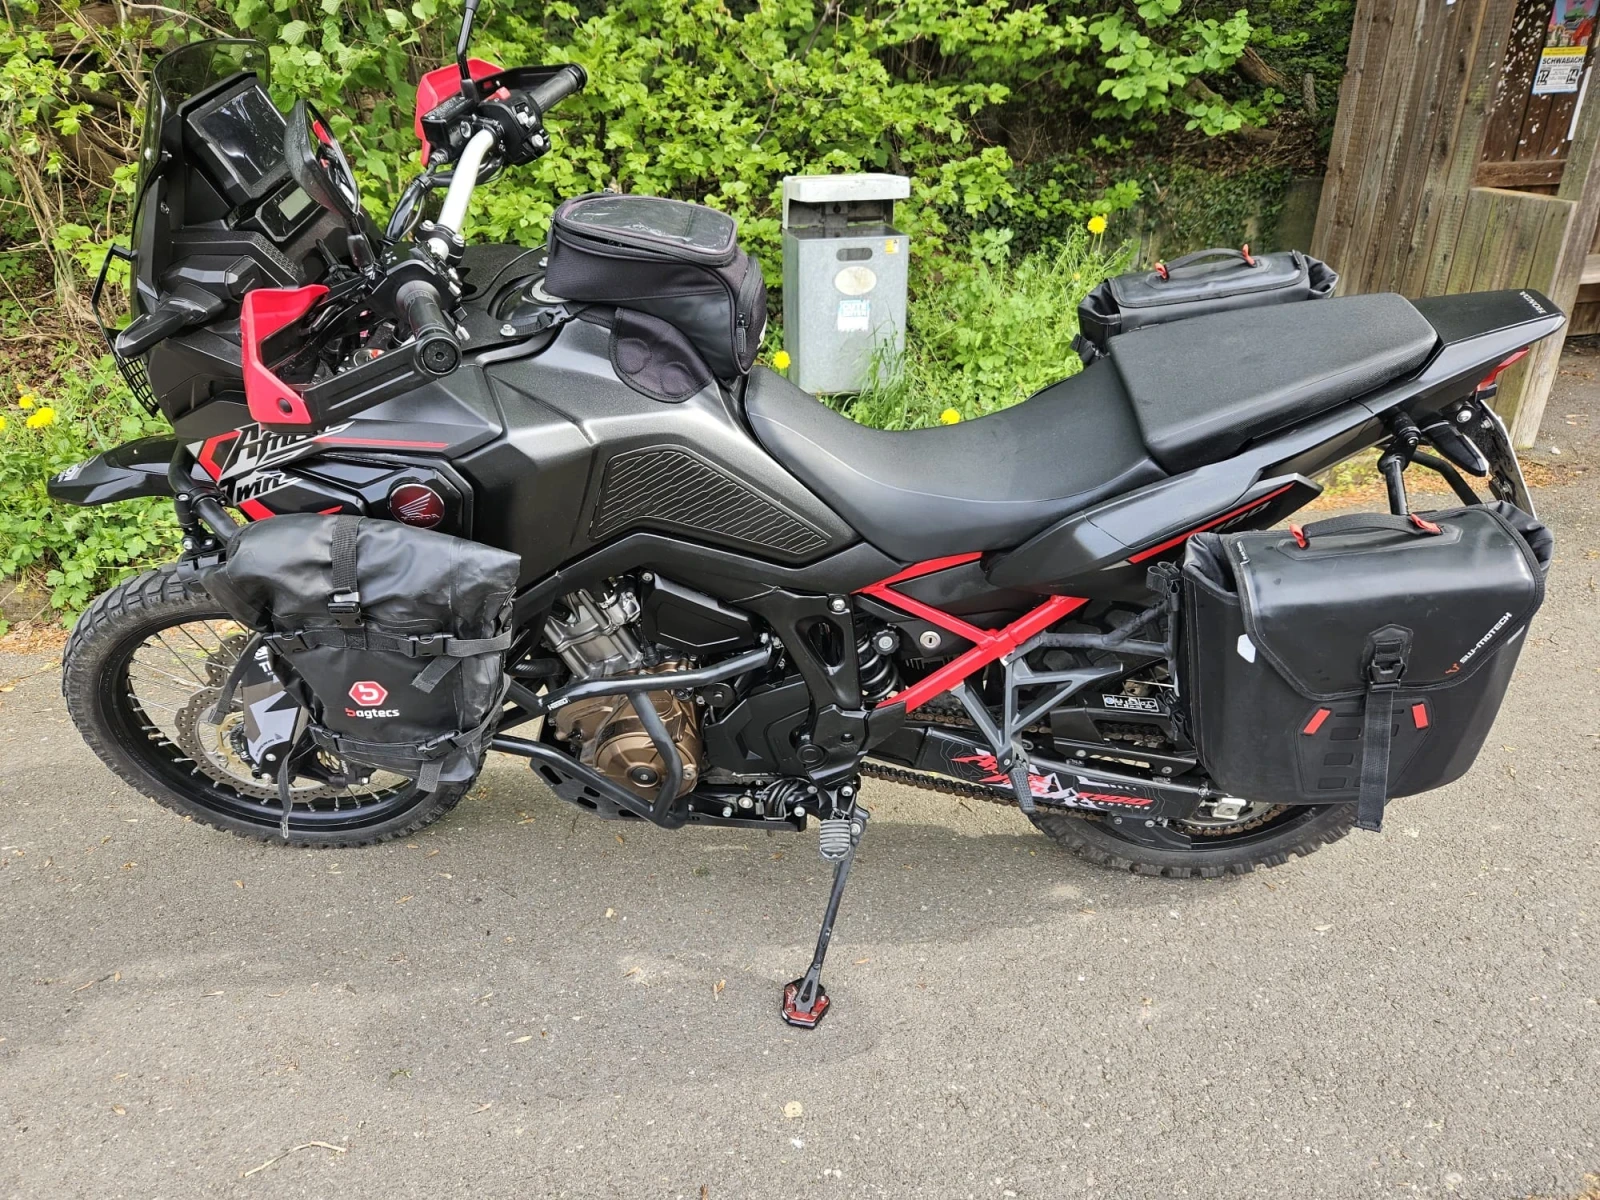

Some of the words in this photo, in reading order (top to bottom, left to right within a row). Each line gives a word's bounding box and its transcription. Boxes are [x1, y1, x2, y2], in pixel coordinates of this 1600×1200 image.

[1542, 57, 1584, 65] SCHWABACH
[1519, 290, 1547, 314] HONDA
[1459, 611, 1512, 664] SW-MOTECH
[345, 707, 400, 719] bagtecs
